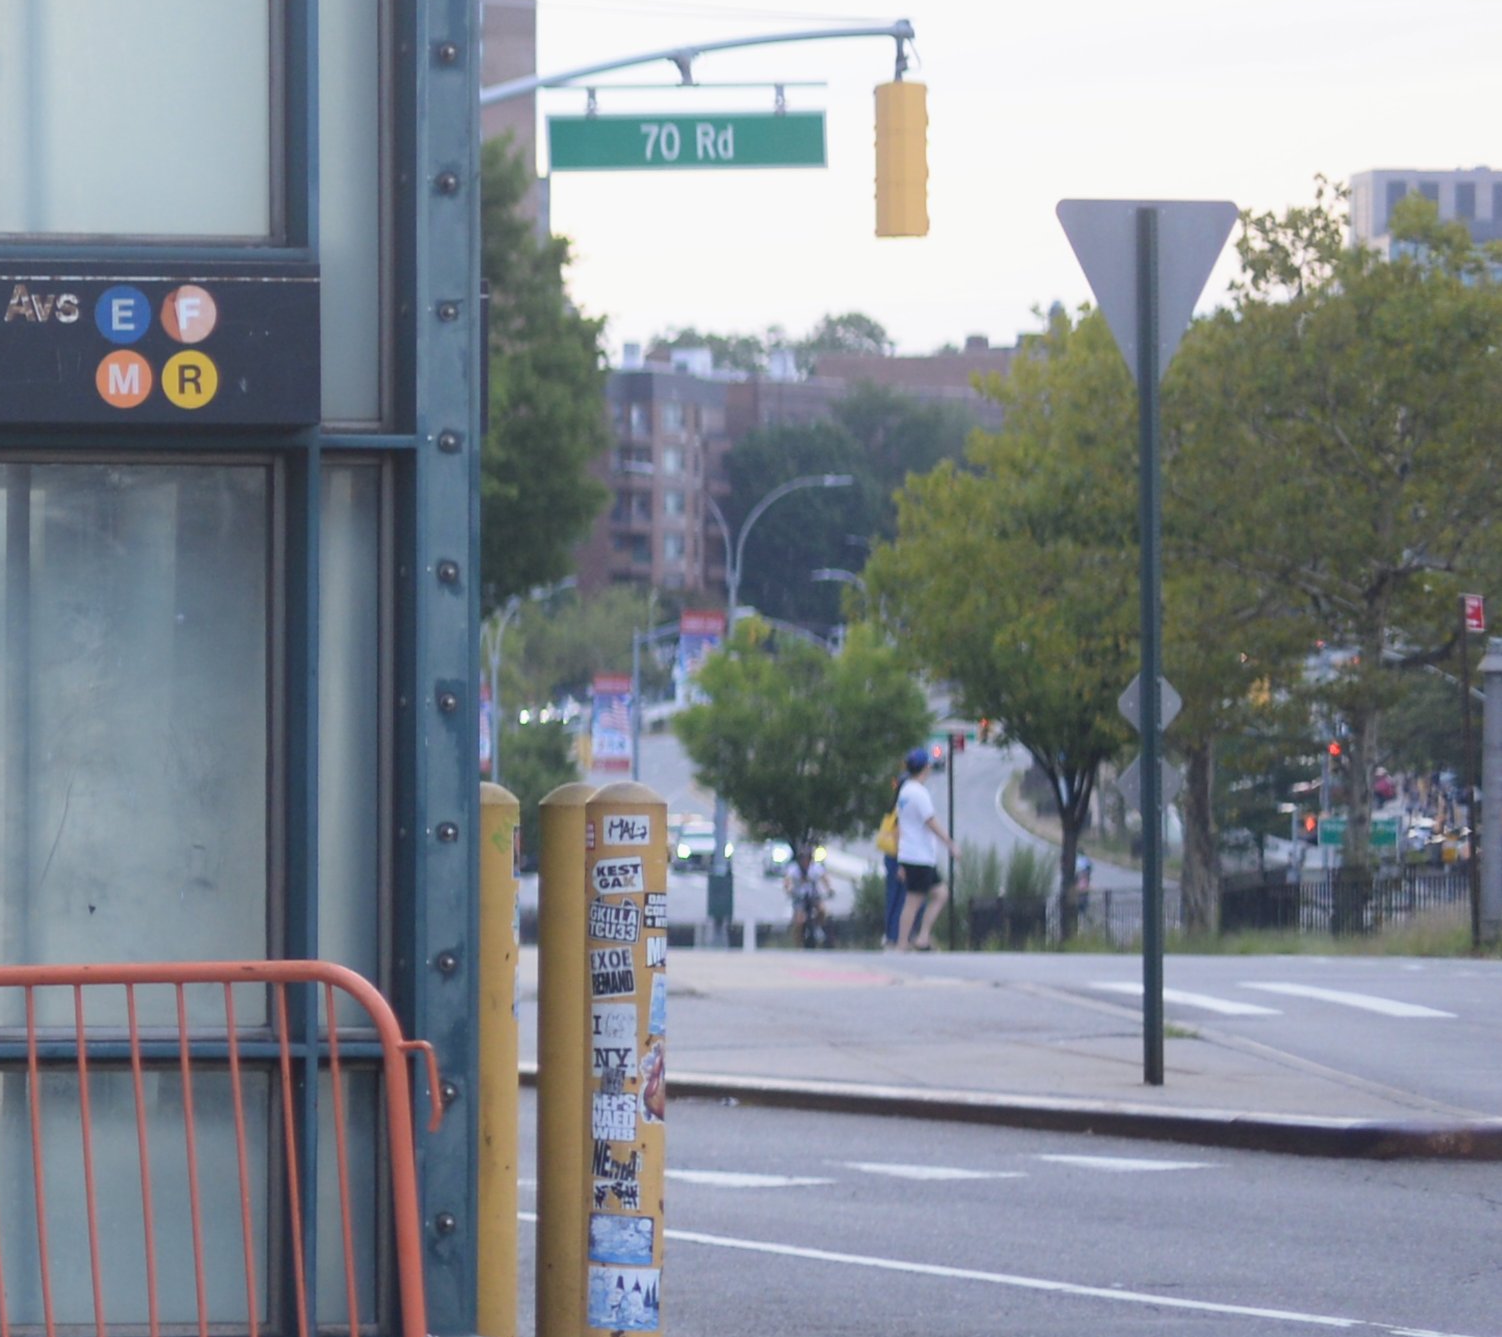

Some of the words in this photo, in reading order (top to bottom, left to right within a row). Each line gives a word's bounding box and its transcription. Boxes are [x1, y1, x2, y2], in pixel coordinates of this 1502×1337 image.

[640, 122, 680, 161] 70
[697, 122, 734, 160] Rd
[4, 283, 80, 324] Avs
[112, 298, 135, 331] E
[177, 298, 202, 331] F
[108, 363, 140, 395] M
[178, 364, 202, 395] R
[597, 864, 640, 878] KEST
[599, 876, 636, 890] GAK
[594, 1048, 632, 1068] NY
